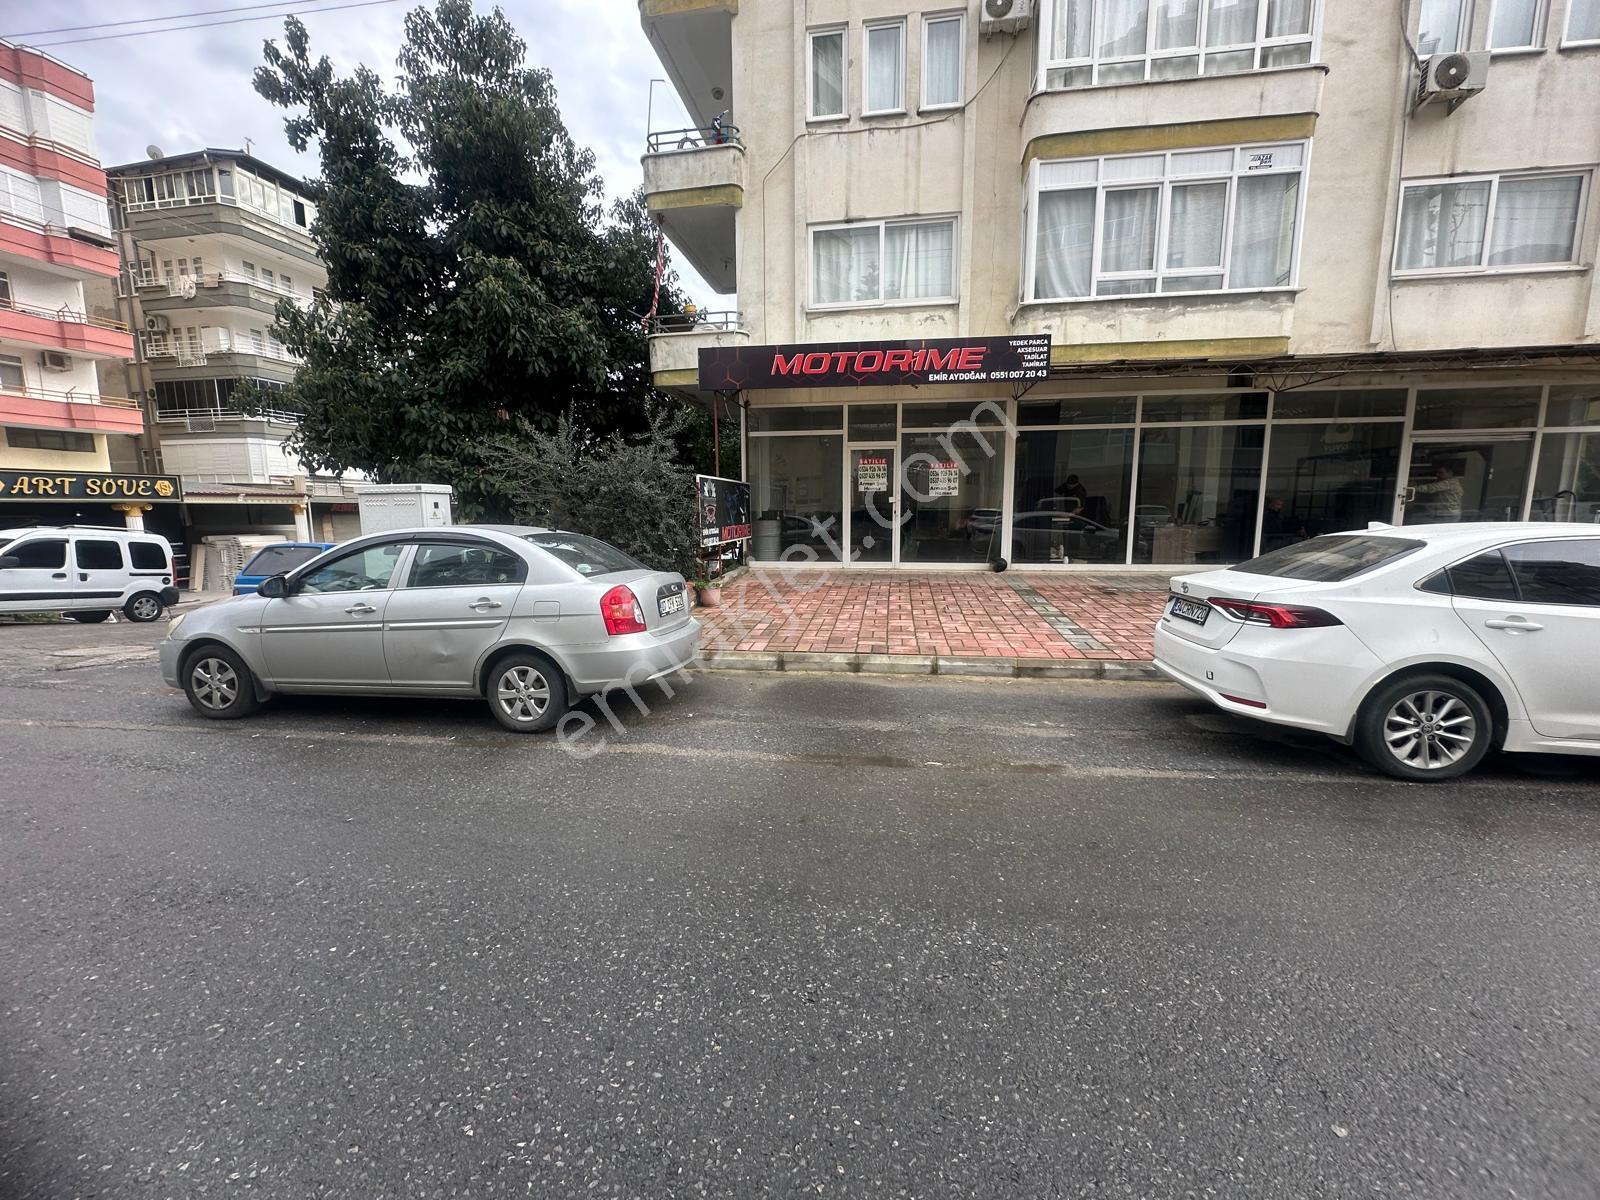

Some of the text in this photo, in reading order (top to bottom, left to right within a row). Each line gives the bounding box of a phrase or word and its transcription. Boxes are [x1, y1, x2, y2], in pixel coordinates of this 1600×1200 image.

[928, 372, 948, 381] EMİR
[949, 371, 986, 381] AYDOĞAN
[990, 371, 1008, 379] 0551
[1009, 371, 1024, 379] 007
[1025, 370, 1036, 378] 20
[11, 476, 76, 495] ART
